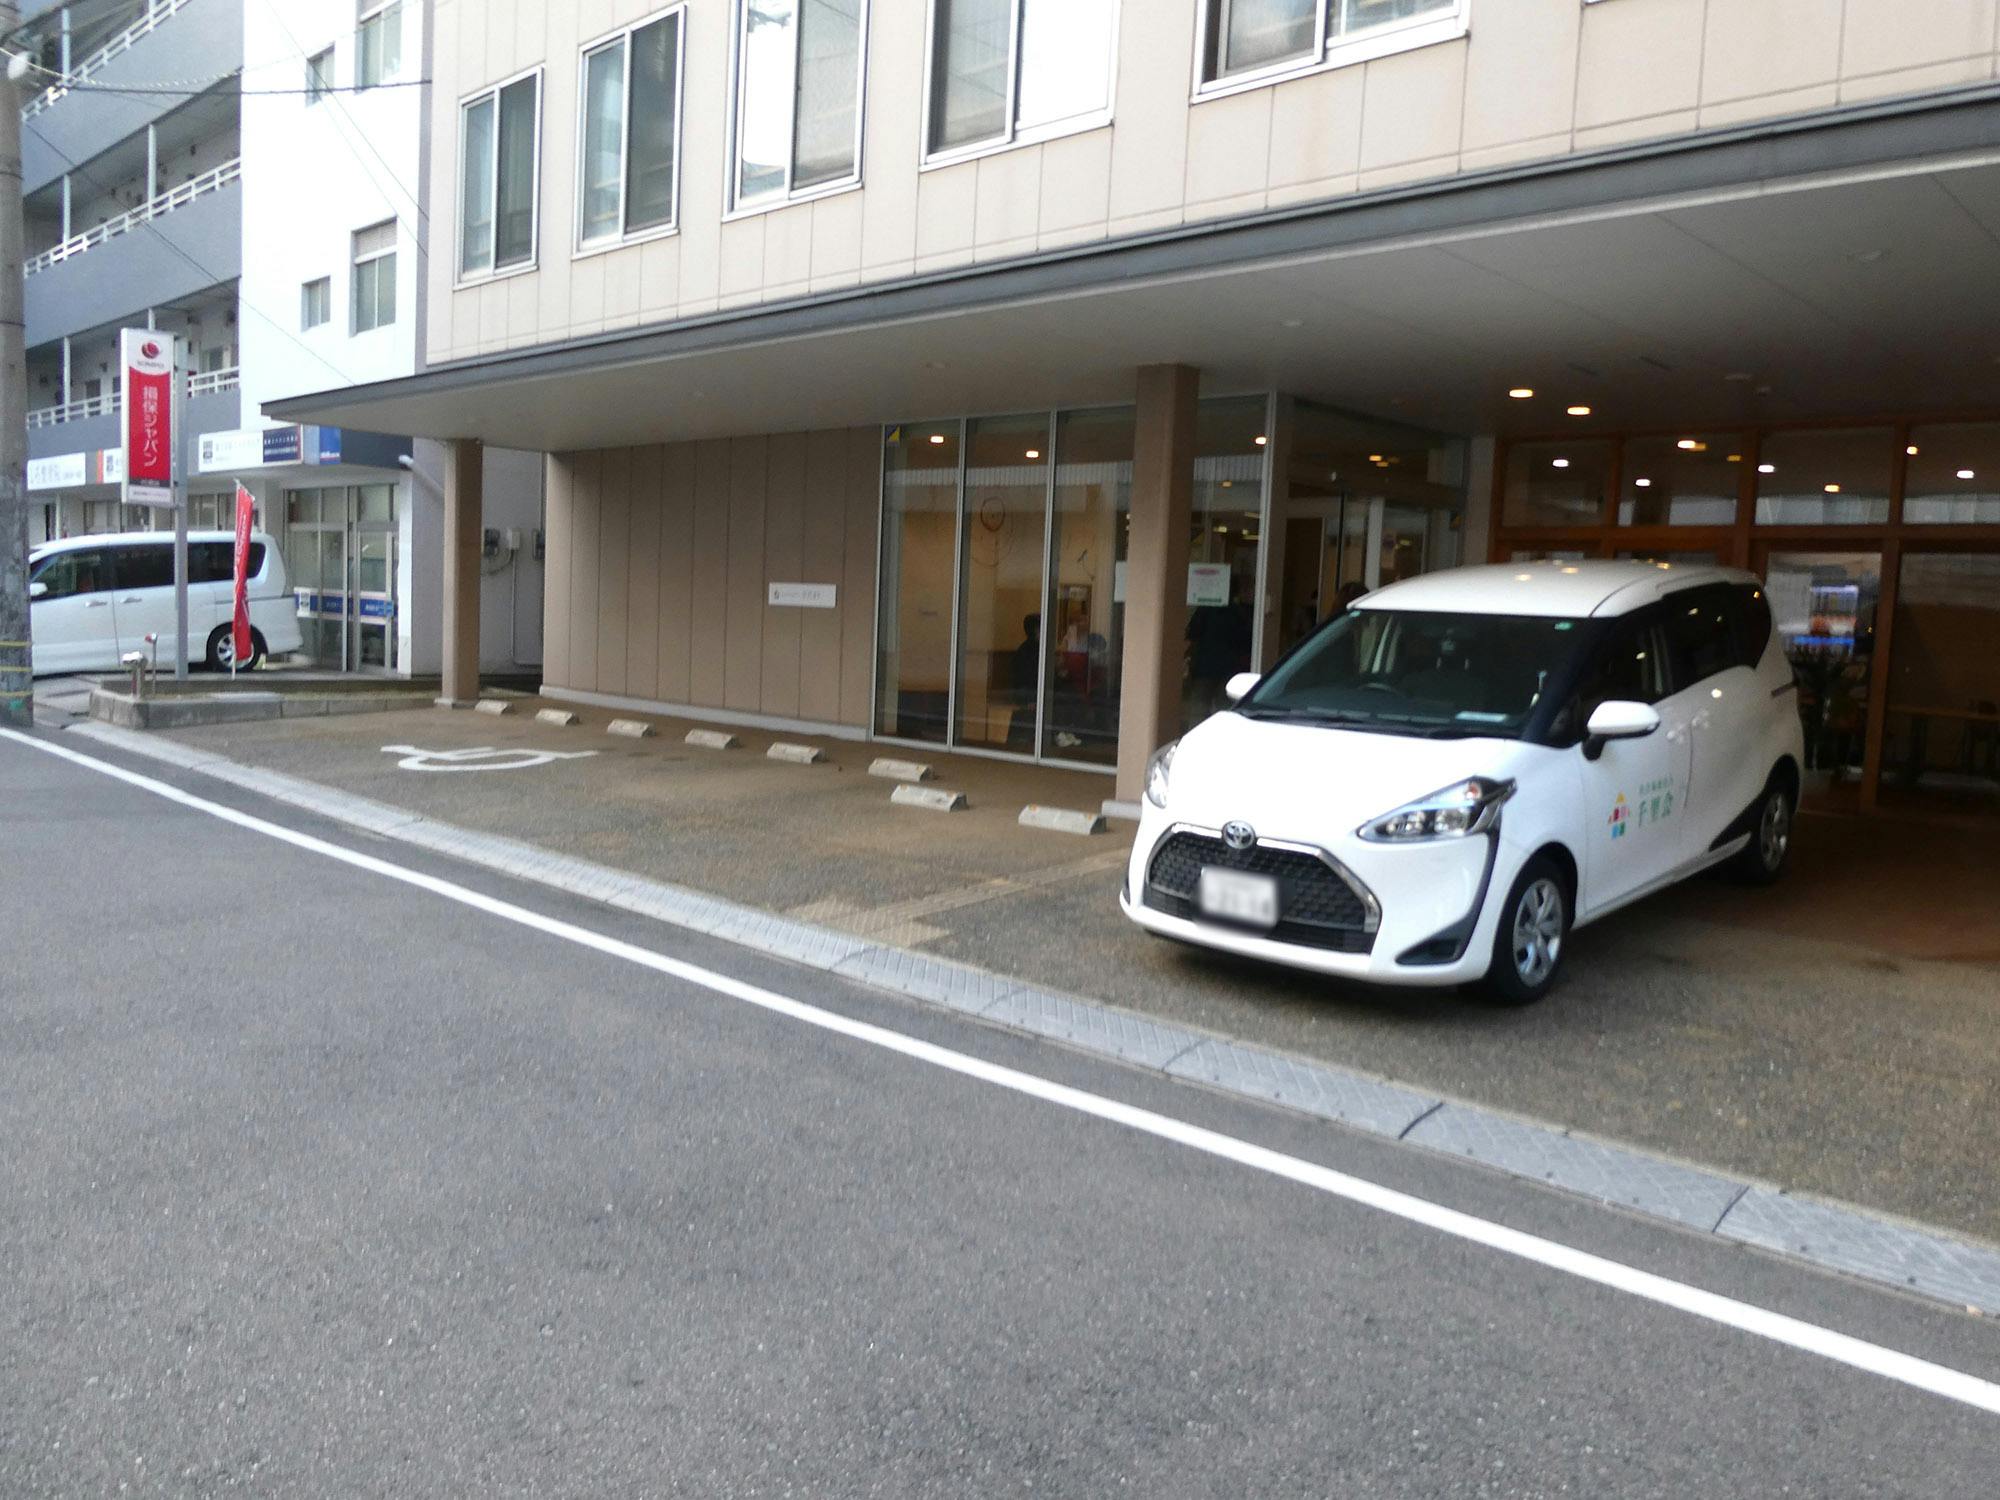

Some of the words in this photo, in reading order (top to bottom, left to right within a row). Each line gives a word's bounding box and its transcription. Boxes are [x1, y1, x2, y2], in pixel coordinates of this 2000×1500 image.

[143, 386, 158, 467] 損保ジャパン
